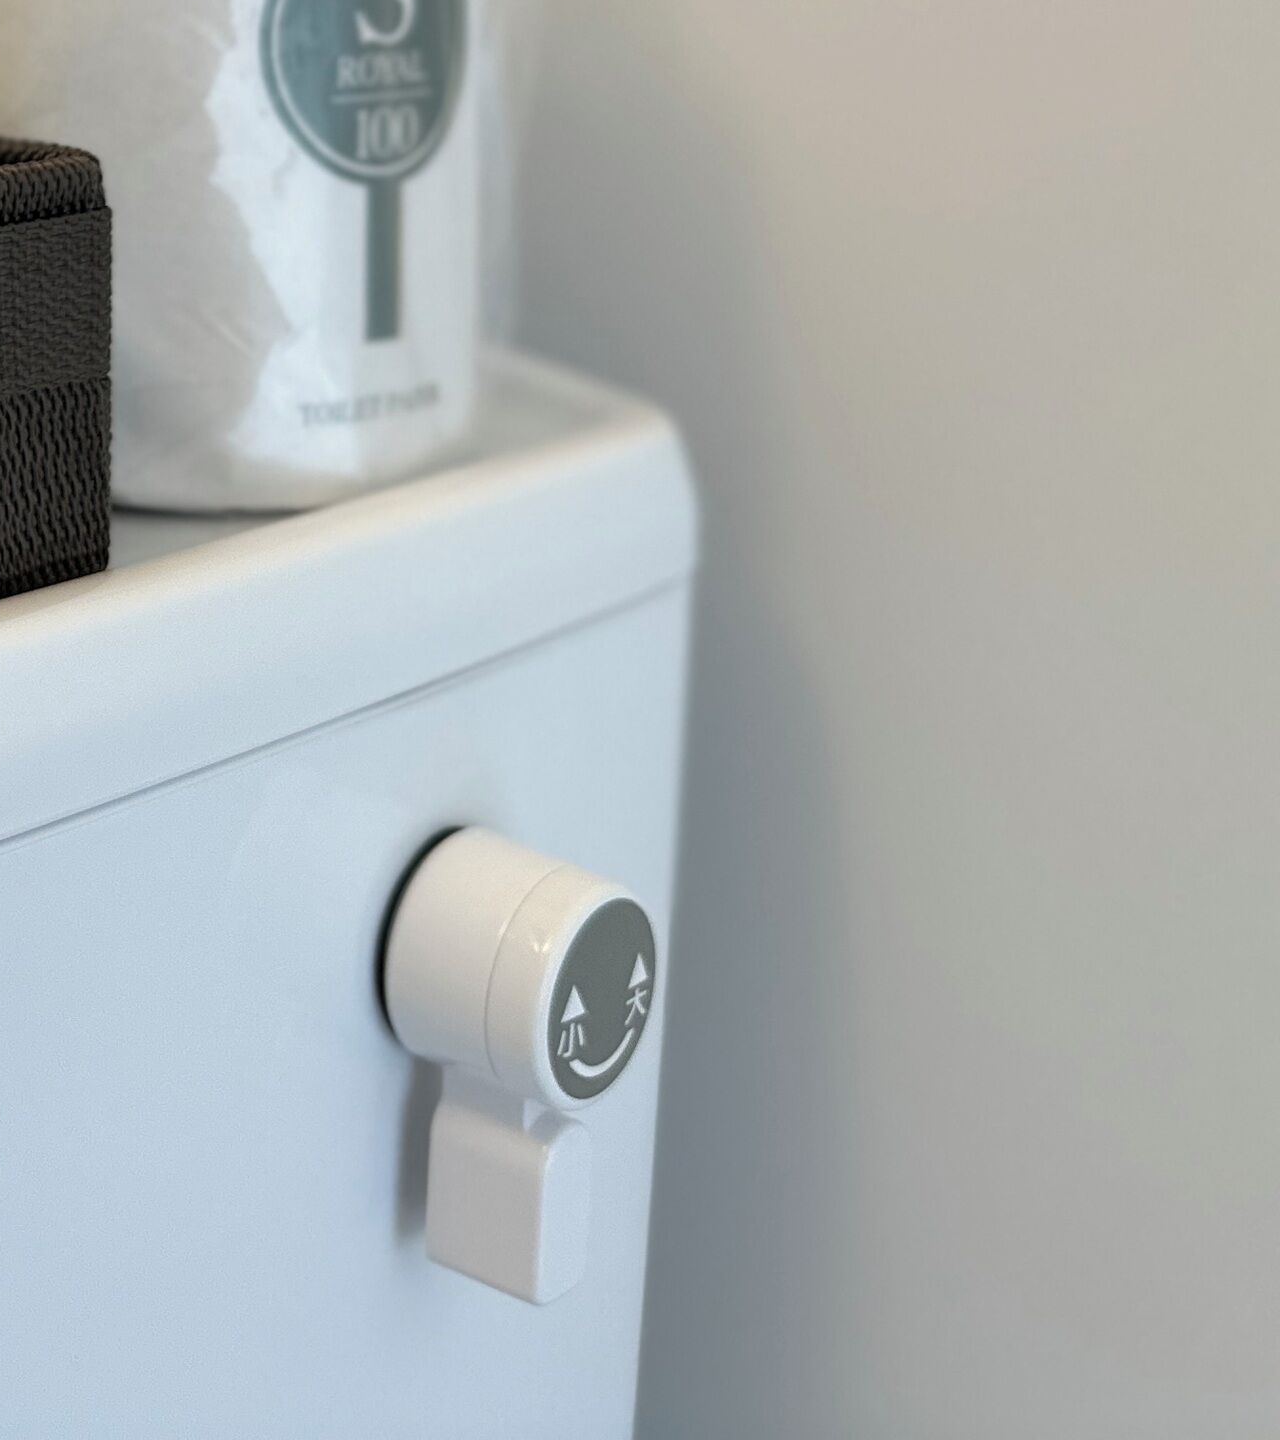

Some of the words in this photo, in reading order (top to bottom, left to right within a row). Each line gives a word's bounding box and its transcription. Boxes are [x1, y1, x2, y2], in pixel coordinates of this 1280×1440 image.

[337, 51, 425, 89] ROYAL
[355, 103, 419, 161] 100
[624, 987, 649, 1027] 大
[556, 1021, 585, 1059] 小
